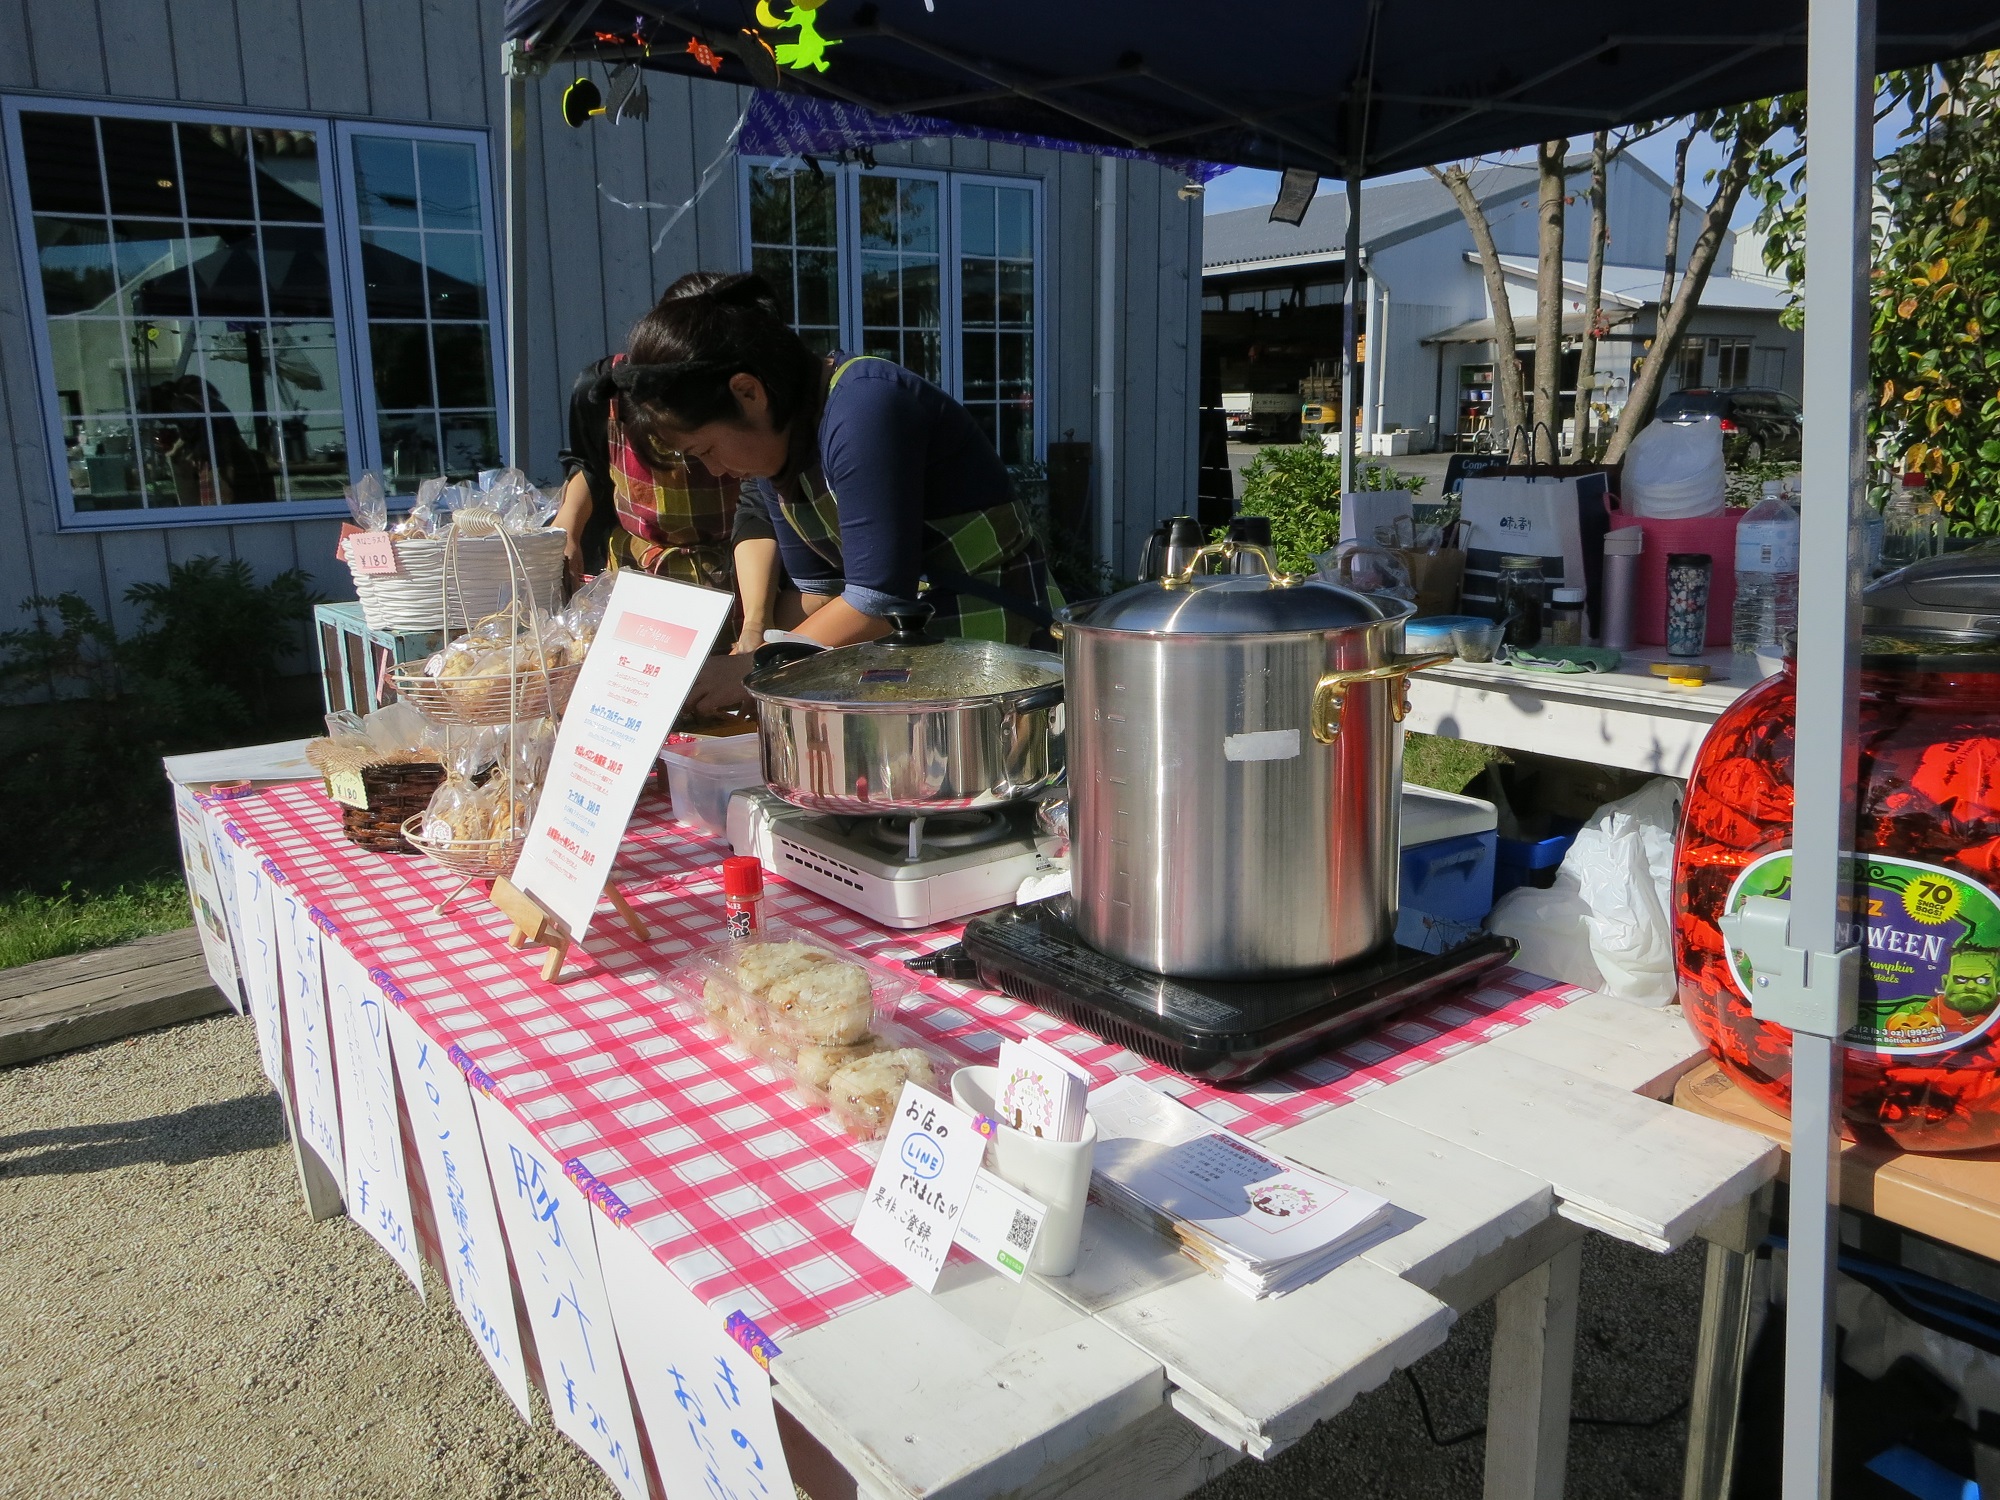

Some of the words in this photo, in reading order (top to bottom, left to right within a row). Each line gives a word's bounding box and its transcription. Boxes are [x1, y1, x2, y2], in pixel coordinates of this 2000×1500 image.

[360, 554, 387, 567] ¥180
[1917, 899, 1946, 911] SNACK
[1918, 880, 1953, 905] 70
[1915, 905, 1942, 917] BAGS!
[1884, 1035, 1911, 1044] Bottom
[1921, 1033, 1944, 1043] Barrel
[360, 991, 399, 1179] ヤミー
[905, 1099, 949, 1139] お店の
[416, 1038, 480, 1288] メロン烏龍茶
[907, 1142, 939, 1171] LINE
[872, 1186, 932, 1243] 是非、ご登録
[508, 1143, 597, 1375] 豚汁
